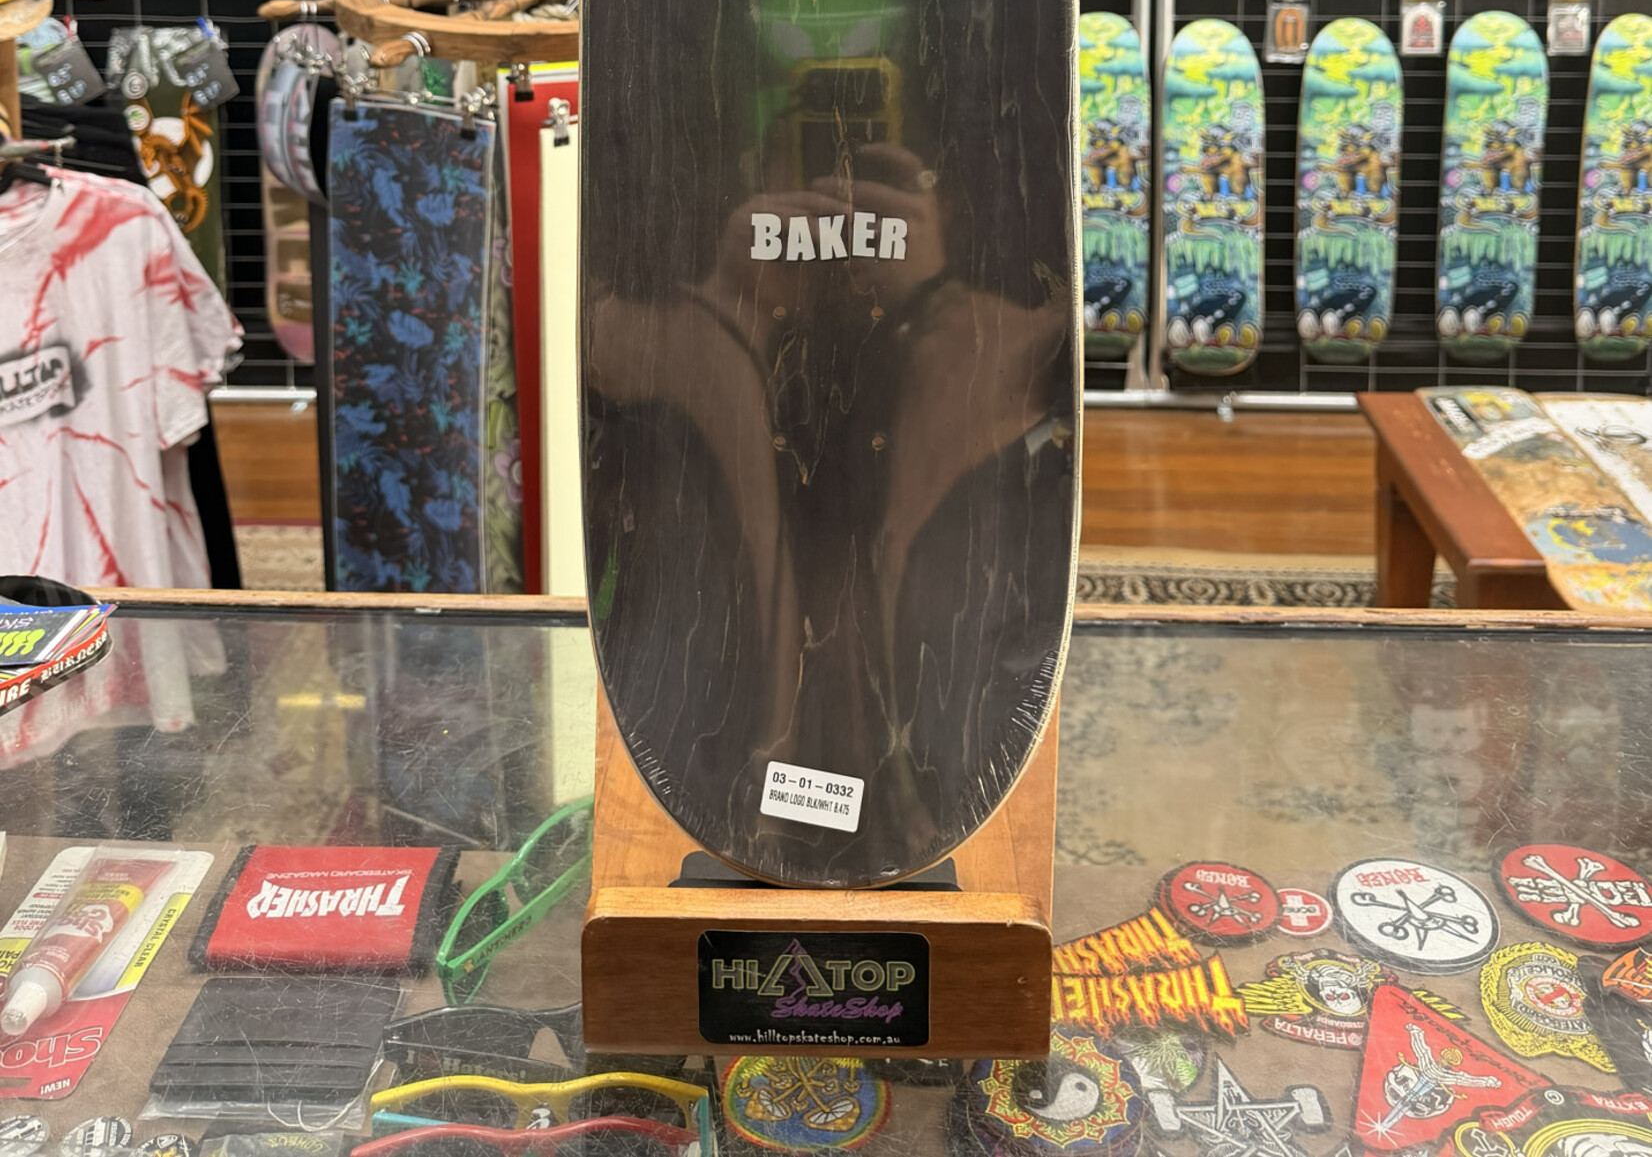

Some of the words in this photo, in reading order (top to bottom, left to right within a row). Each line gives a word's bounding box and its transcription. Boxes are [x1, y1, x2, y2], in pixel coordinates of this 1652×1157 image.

[750, 211, 908, 262] BAKER
[769, 789, 790, 803] BRAND
[790, 793, 806, 807] LOGO
[245, 873, 410, 920] THRASHER
[729, 1029, 901, 1046] www.hilltopskateshop.com.au
[1274, 1017, 1348, 1045] PERALTA
[0, 1027, 103, 1069] Sho
[40, 1078, 71, 1095] NEW!
[1591, 1094, 1648, 1110] EXTRA
[1491, 1104, 1533, 1129] TOUGH
